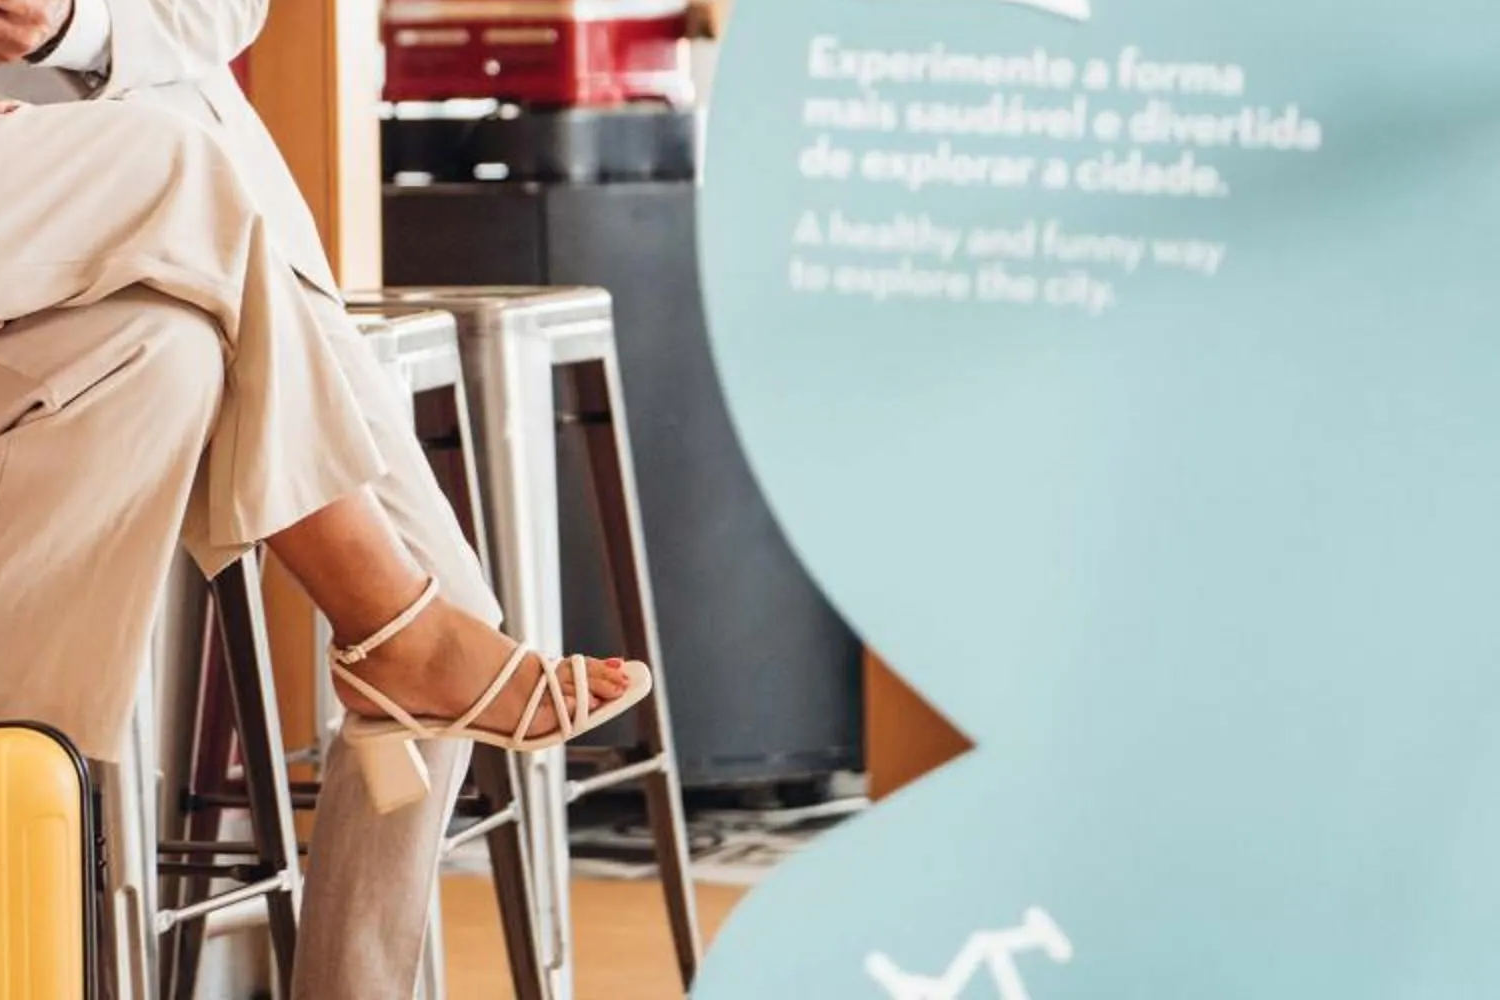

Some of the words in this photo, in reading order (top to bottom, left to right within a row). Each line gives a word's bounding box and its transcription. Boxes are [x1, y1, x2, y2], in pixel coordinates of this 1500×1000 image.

[810, 36, 1075, 84] Experimente
[1083, 58, 1108, 89] a
[1119, 47, 1243, 95] forma
[805, 94, 897, 130] mais
[907, 95, 1086, 138] saudável
[1095, 108, 1121, 140] e
[1131, 101, 1321, 149] divertida
[801, 135, 852, 177] de
[862, 143, 1034, 189] explorar
[1043, 155, 1069, 186] a
[1077, 152, 1228, 196] cidade.
[794, 212, 822, 244] A
[830, 212, 961, 259] healthy
[968, 221, 1036, 257] and
[1045, 220, 1144, 272] funny
[1154, 240, 1226, 274] way
[791, 257, 830, 290] to
[835, 259, 970, 300] explore
[978, 262, 1037, 299] the
